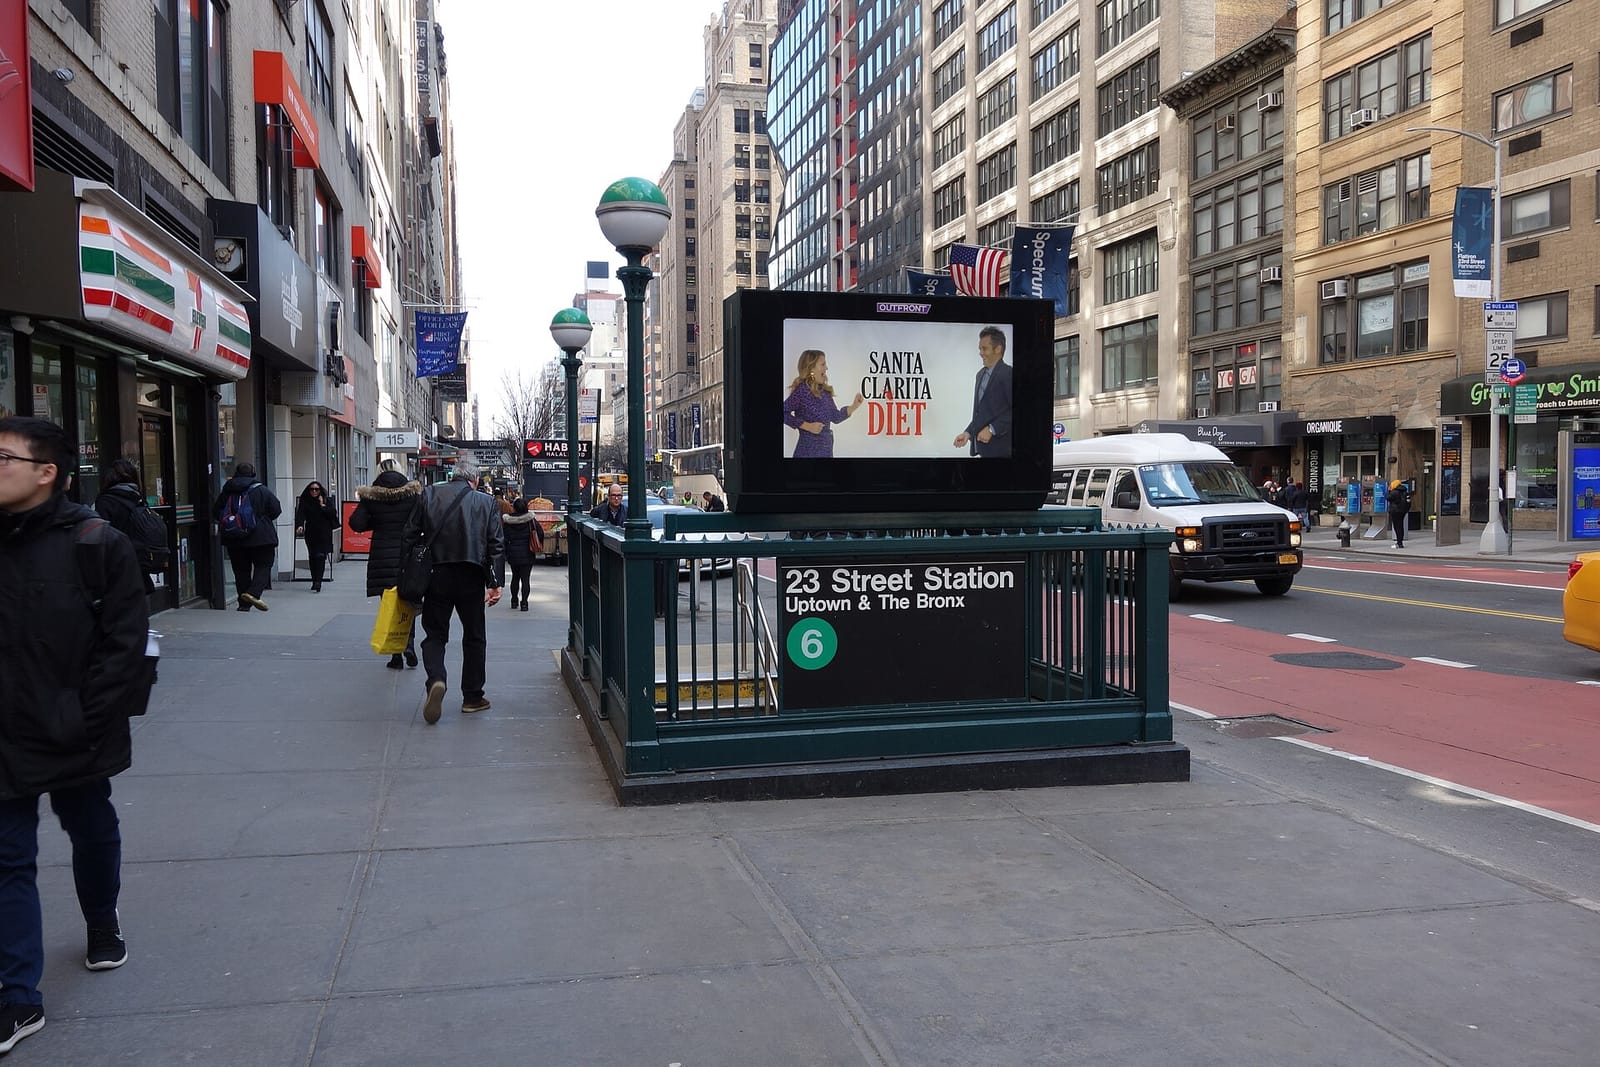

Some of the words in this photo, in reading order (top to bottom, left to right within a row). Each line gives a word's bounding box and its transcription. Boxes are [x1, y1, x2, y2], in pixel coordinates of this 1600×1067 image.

[880, 304, 926, 312] OUTFRONT
[870, 351, 924, 374] SANTA
[862, 376, 932, 400] CLARITA
[1219, 368, 1256, 388] YOGA
[868, 402, 926, 435] DIET
[1306, 421, 1342, 433] ORGANIQUE
[386, 434, 404, 445] 115
[1310, 450, 1318, 493] ORGANIQUE
[786, 570, 820, 593] 23
[831, 568, 912, 592] Street
[923, 566, 1014, 591] Station
[786, 596, 850, 615] Uptown
[858, 595, 871, 610] &
[878, 594, 910, 610] The
[916, 593, 965, 609] Bronx
[801, 629, 824, 658] 6
